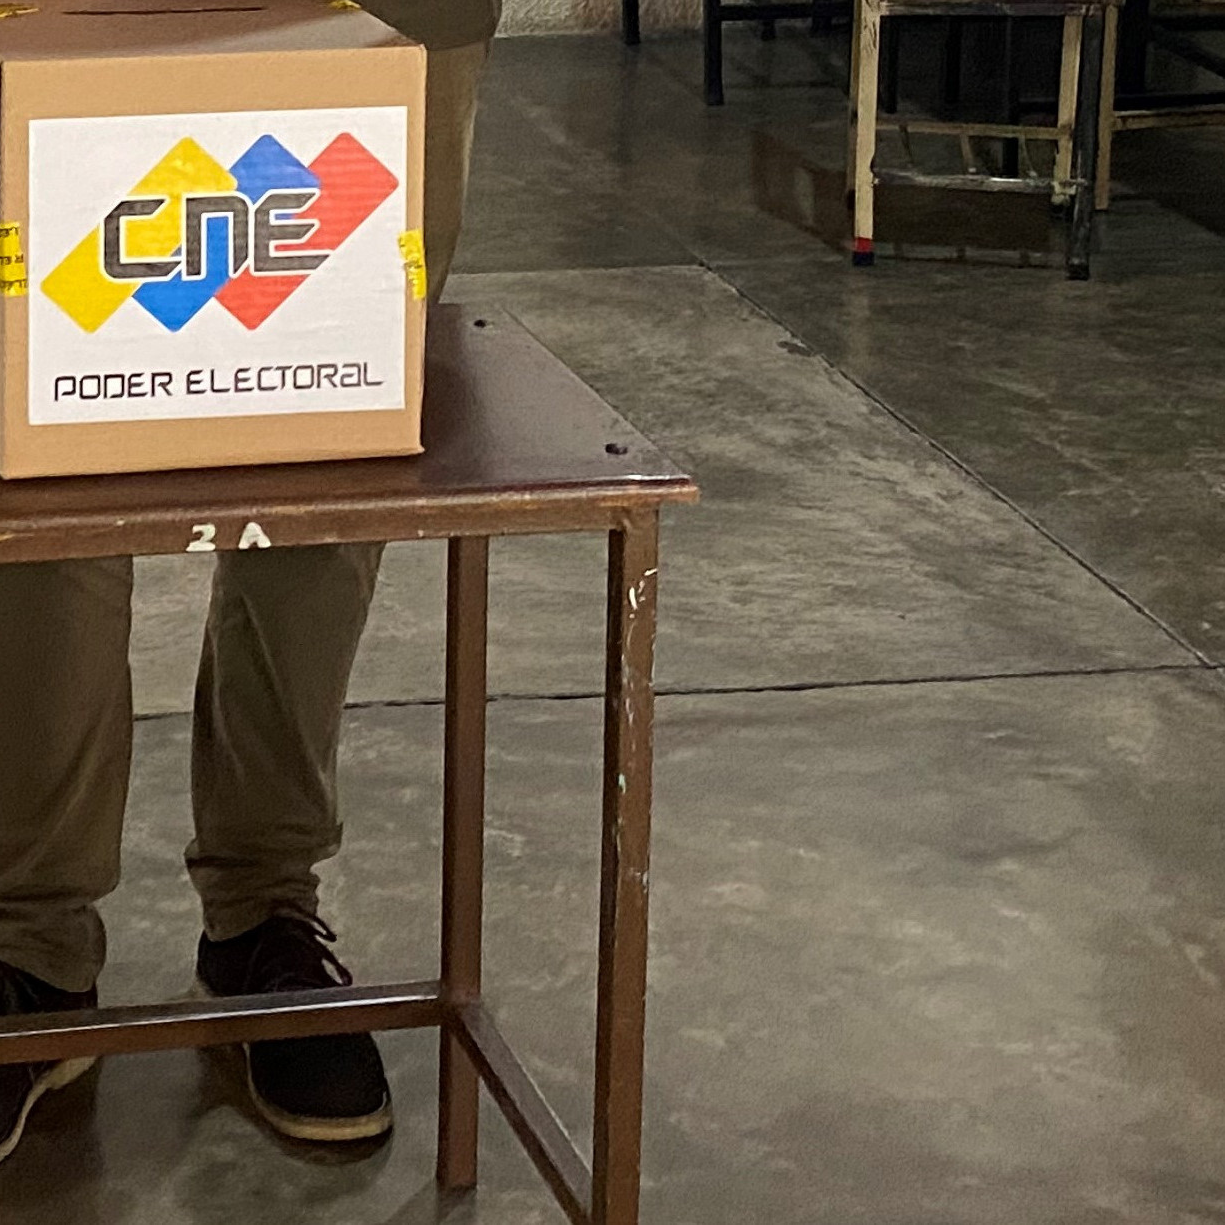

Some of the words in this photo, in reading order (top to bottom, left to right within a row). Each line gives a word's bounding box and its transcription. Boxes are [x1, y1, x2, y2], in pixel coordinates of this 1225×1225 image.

[103, 192, 330, 279] CNE
[54, 372, 173, 401] PODER
[186, 362, 384, 394] ELECTORAL
[185, 523, 216, 552] 2
[238, 522, 272, 549] A
